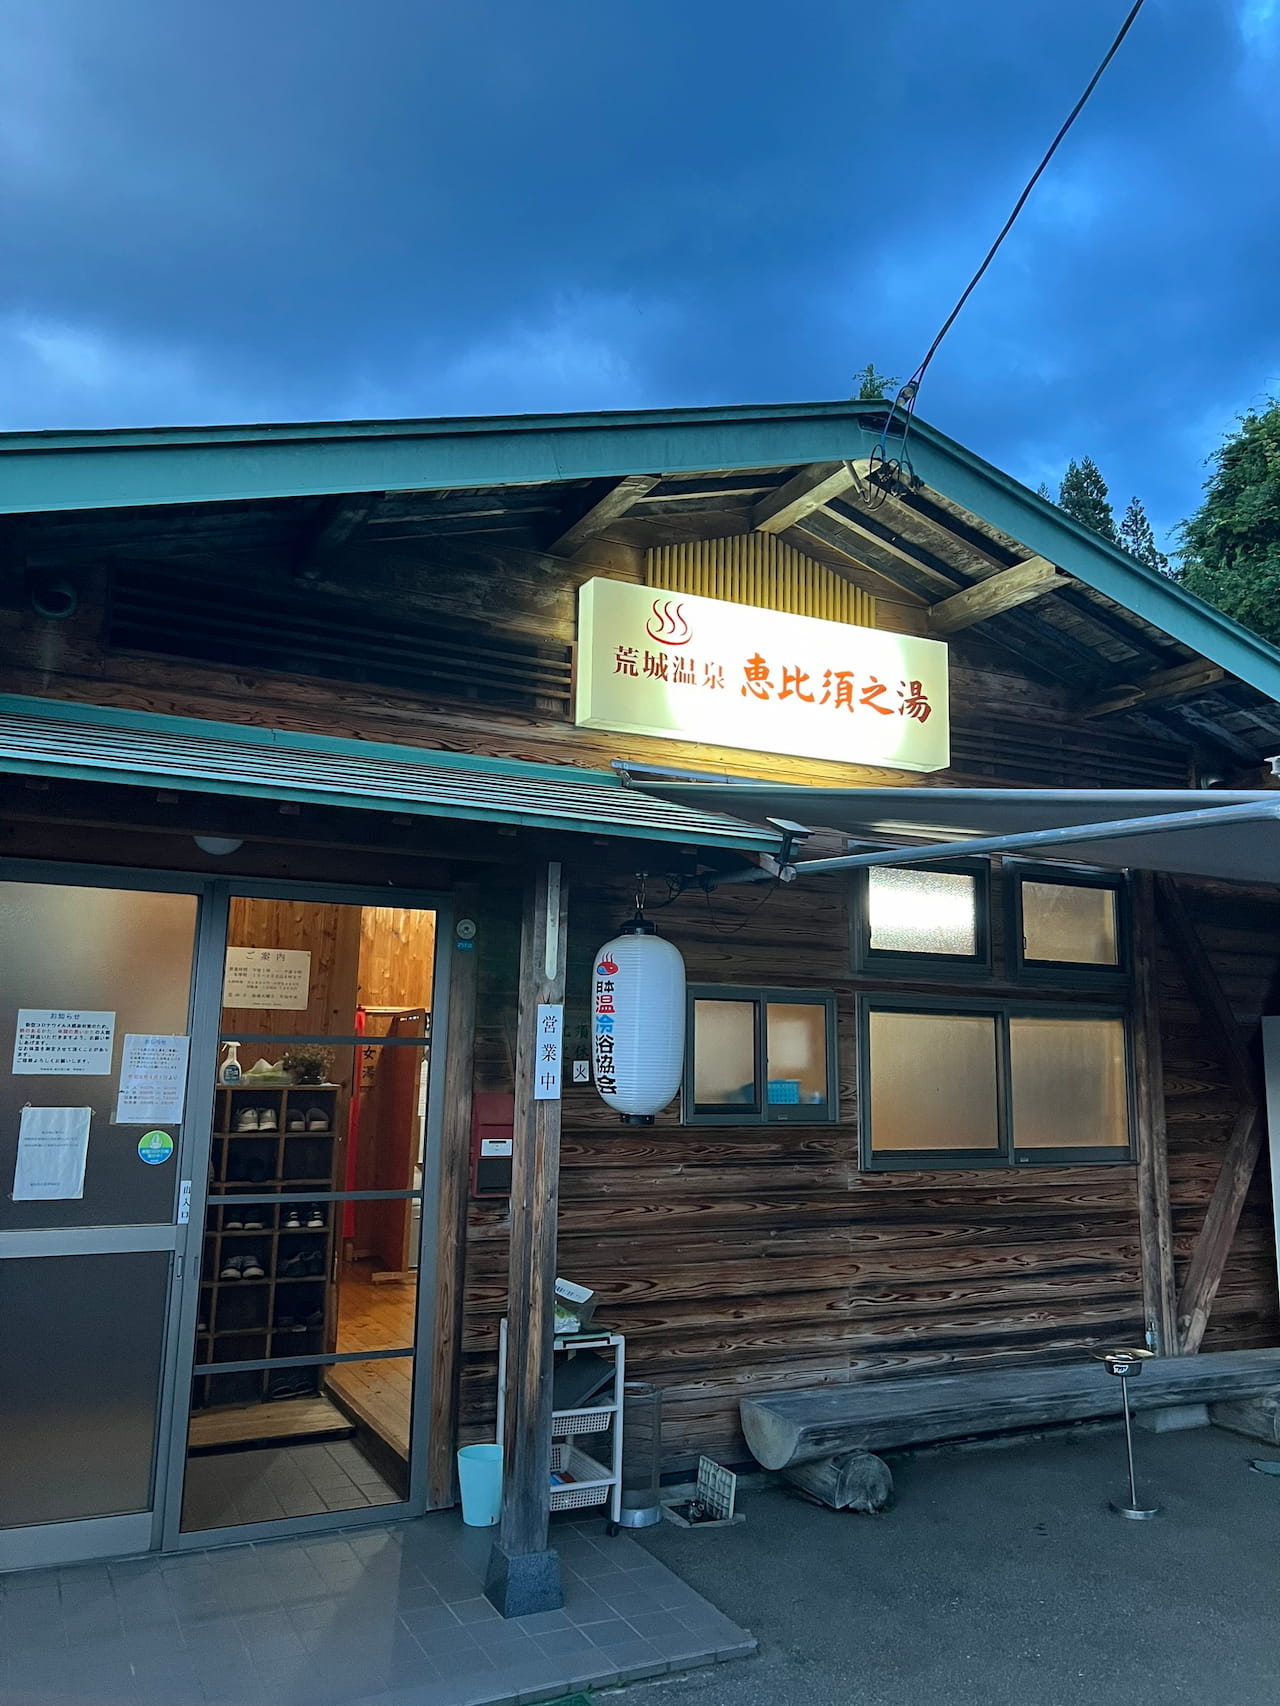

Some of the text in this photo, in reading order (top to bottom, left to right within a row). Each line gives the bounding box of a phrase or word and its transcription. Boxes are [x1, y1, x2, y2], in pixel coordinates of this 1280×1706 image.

[613, 645, 933, 724] 荒城温泉 恵比須之湯
[246, 951, 286, 962] ご案内
[541, 1015, 558, 1091] 営業中
[574, 1064, 587, 1079] 火
[181, 1185, 192, 1219] 出入口
